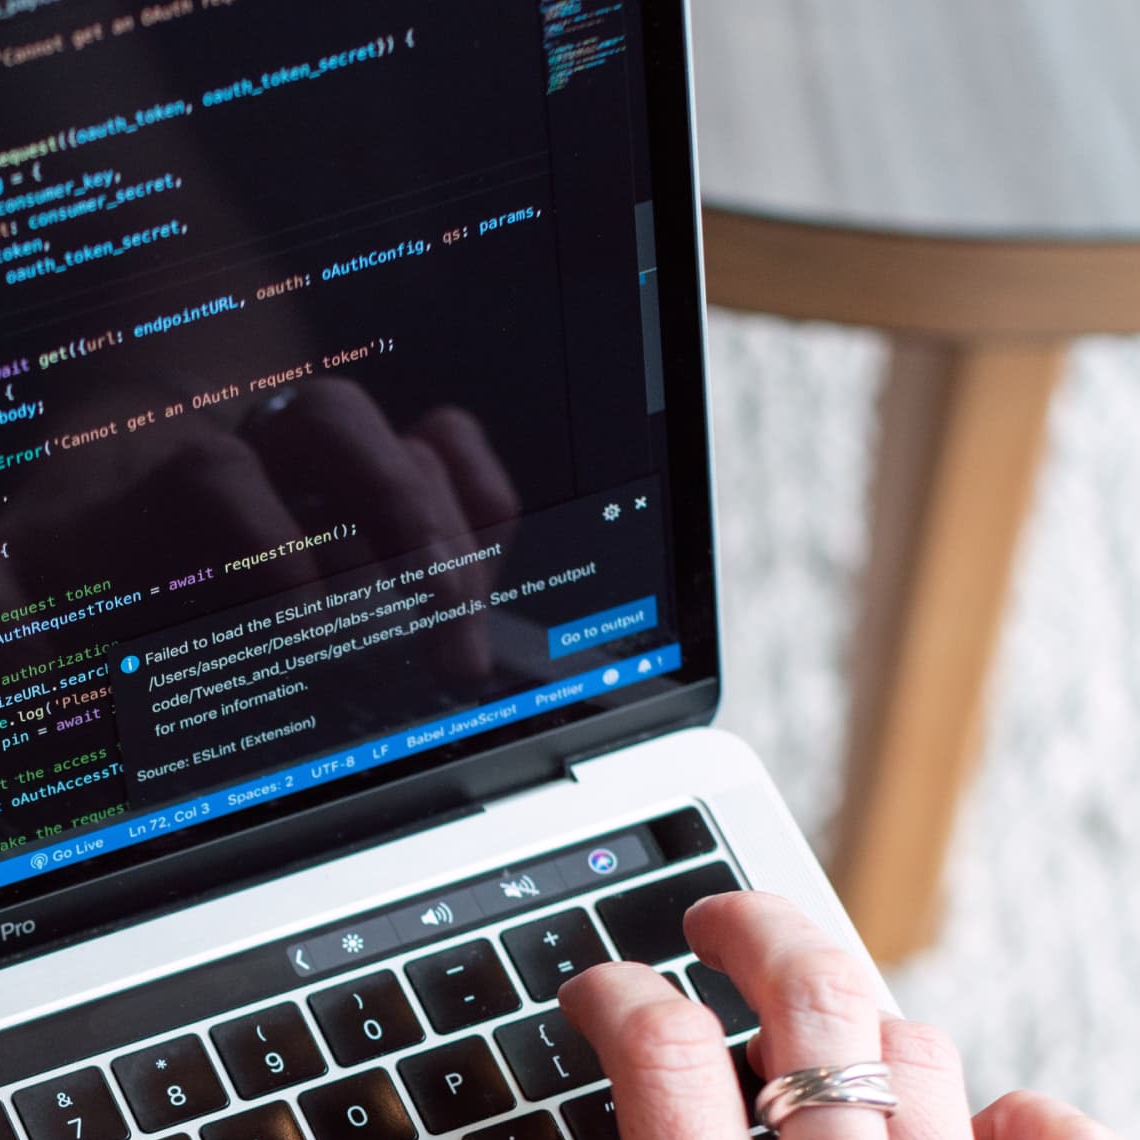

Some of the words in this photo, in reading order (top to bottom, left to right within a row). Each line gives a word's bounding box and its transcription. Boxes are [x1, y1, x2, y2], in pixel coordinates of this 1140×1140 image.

[201, 35, 395, 107] oauth_token_secret})
[27, 171, 183, 231] consumer_secret,
[5, 219, 188, 285] oauth_token_secret,
[38, 330, 123, 370] get({url:
[132, 294, 245, 338] endpointURL,
[256, 273, 311, 300] oauth:
[320, 239, 432, 281] oAuthConfig,
[442, 225, 468, 245] qs:
[478, 206, 541, 236] params,
[126, 410, 155, 433] get
[164, 402, 184, 418] an
[191, 383, 239, 409] OAuth
[249, 361, 313, 392] request
[322, 337, 394, 369] token');
[168, 567, 214, 591] await
[224, 523, 357, 574] requestToken();
[65, 579, 111, 602] token
[144, 639, 189, 666] Failed
[191, 637, 209, 651] to
[210, 622, 244, 645] load
[246, 617, 272, 633] the
[274, 599, 323, 625] ESLint
[325, 585, 372, 609] library
[374, 577, 397, 593] for
[399, 568, 425, 585] the
[427, 542, 502, 576] document
[148, 592, 435, 693] /Users/aspecker/Desktop/labs-sample-
[151, 598, 487, 713] code/Tweets_and_Users/get_users_payload.js.
[489, 588, 518, 606] See
[520, 579, 546, 596] the
[547, 561, 596, 587] output
[560, 631, 581, 646] Go
[582, 626, 598, 639] to
[599, 609, 645, 633] output
[154, 721, 176, 737] for
[179, 708, 218, 730] more
[220, 681, 309, 716] information.
[534, 682, 584, 706] Prettier
[1, 731, 30, 752] pin
[55, 707, 101, 732] await
[406, 726, 445, 749] Babel
[448, 703, 517, 735] JavaScript
[13, 768, 45, 784] the
[53, 747, 107, 774] access
[136, 757, 190, 782] Source:
[191, 741, 237, 765] ESLint
[239, 714, 317, 751] (Extension)
[310, 754, 356, 779] UTF-8
[371, 743, 389, 760] LF
[226, 782, 282, 806] Spaces:
[284, 774, 294, 788] 2
[35, 823, 62, 839] the
[71, 803, 126, 828] reques
[128, 824, 147, 839] Ln
[148, 815, 171, 831] 72,
[173, 805, 198, 823] Col
[200, 801, 211, 815] 3
[51, 848, 73, 862] Go
[74, 838, 104, 855] Live
[0, 919, 36, 941] Pro
[364, 1020, 382, 1040] 0
[265, 1052, 284, 1073] 9
[167, 1086, 186, 1105] 8
[445, 1073, 462, 1094] P
[68, 1118, 81, 1139] 7
[347, 1106, 368, 1126] O
